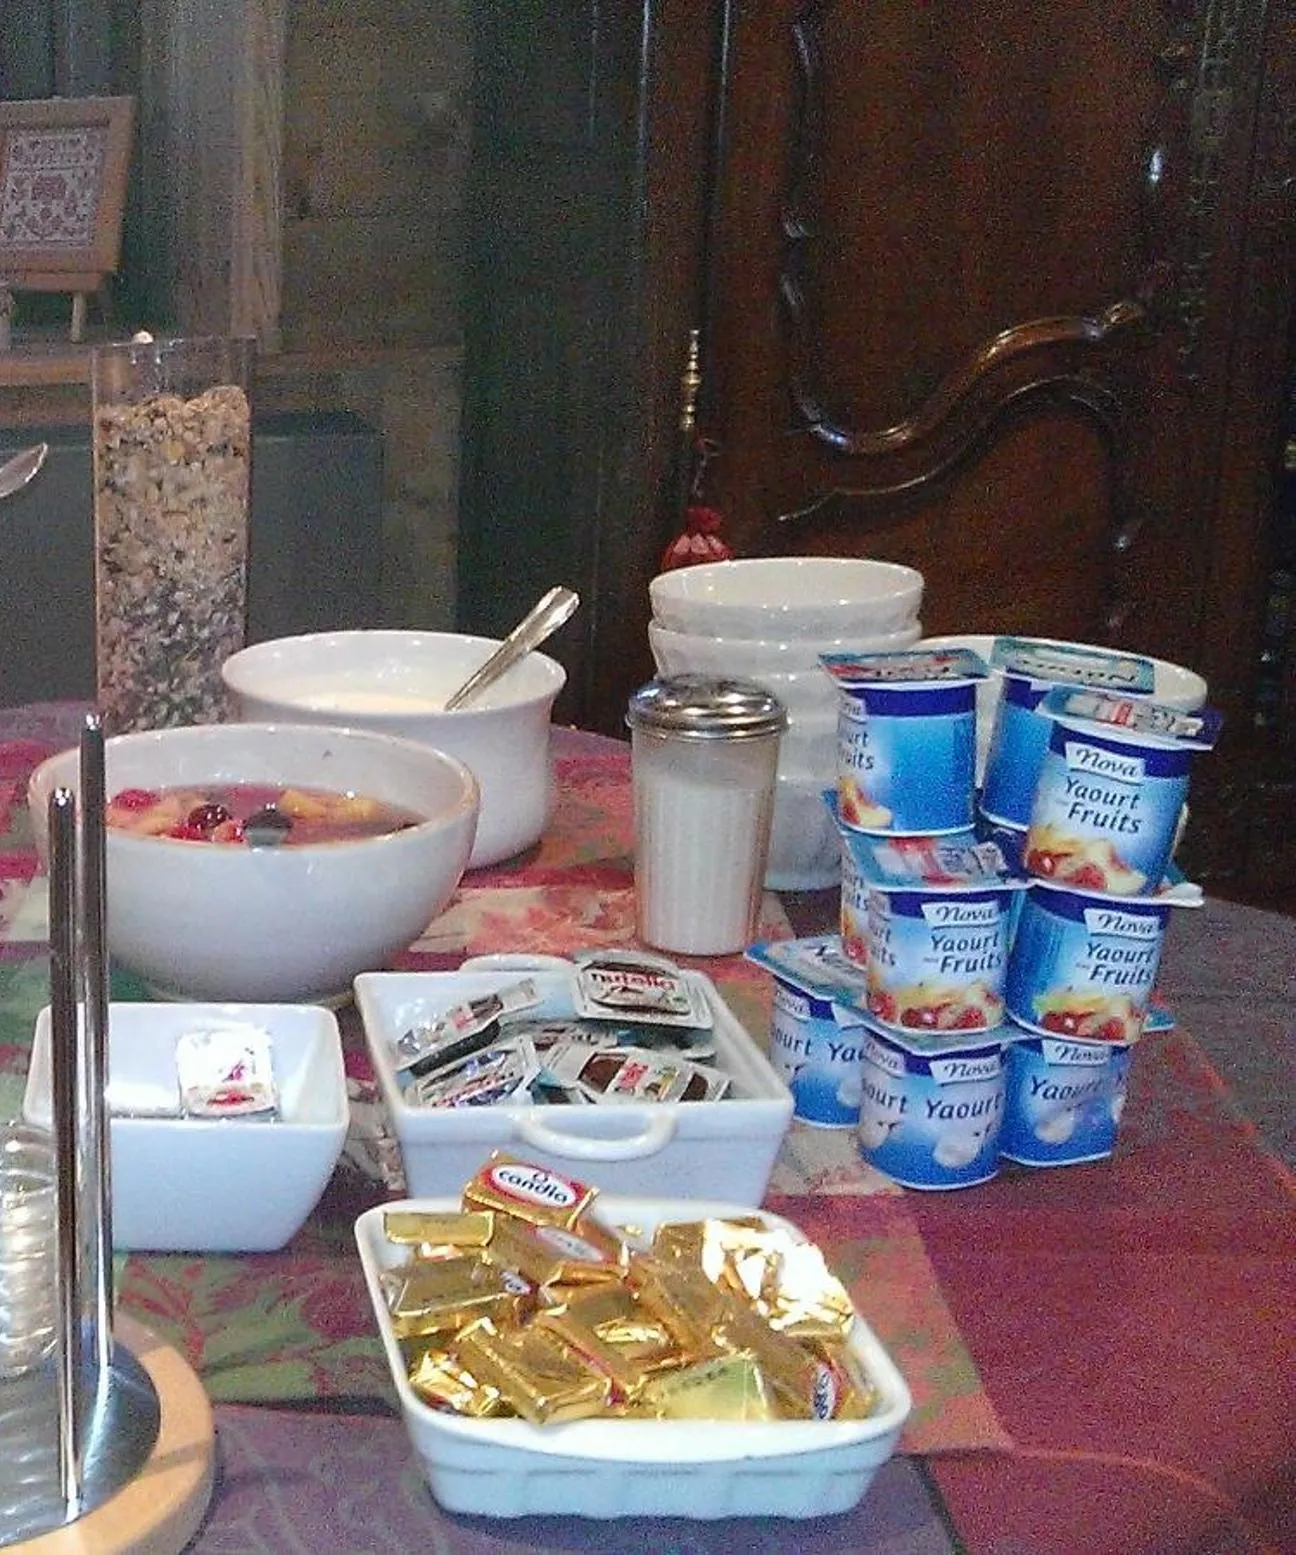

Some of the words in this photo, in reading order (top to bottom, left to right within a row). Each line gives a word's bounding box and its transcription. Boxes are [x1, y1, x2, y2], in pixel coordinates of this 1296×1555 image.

[1065, 776, 1140, 809] Yaourt
[1067, 802, 1142, 834] Fruits
[931, 933, 999, 952] Yaourt
[1087, 942, 1155, 964] Yaourt
[940, 952, 1002, 973] Fruits
[1089, 964, 1151, 985] Fruits
[925, 1091, 1004, 1120] Yaourt
[499, 1170, 568, 1203] candia
